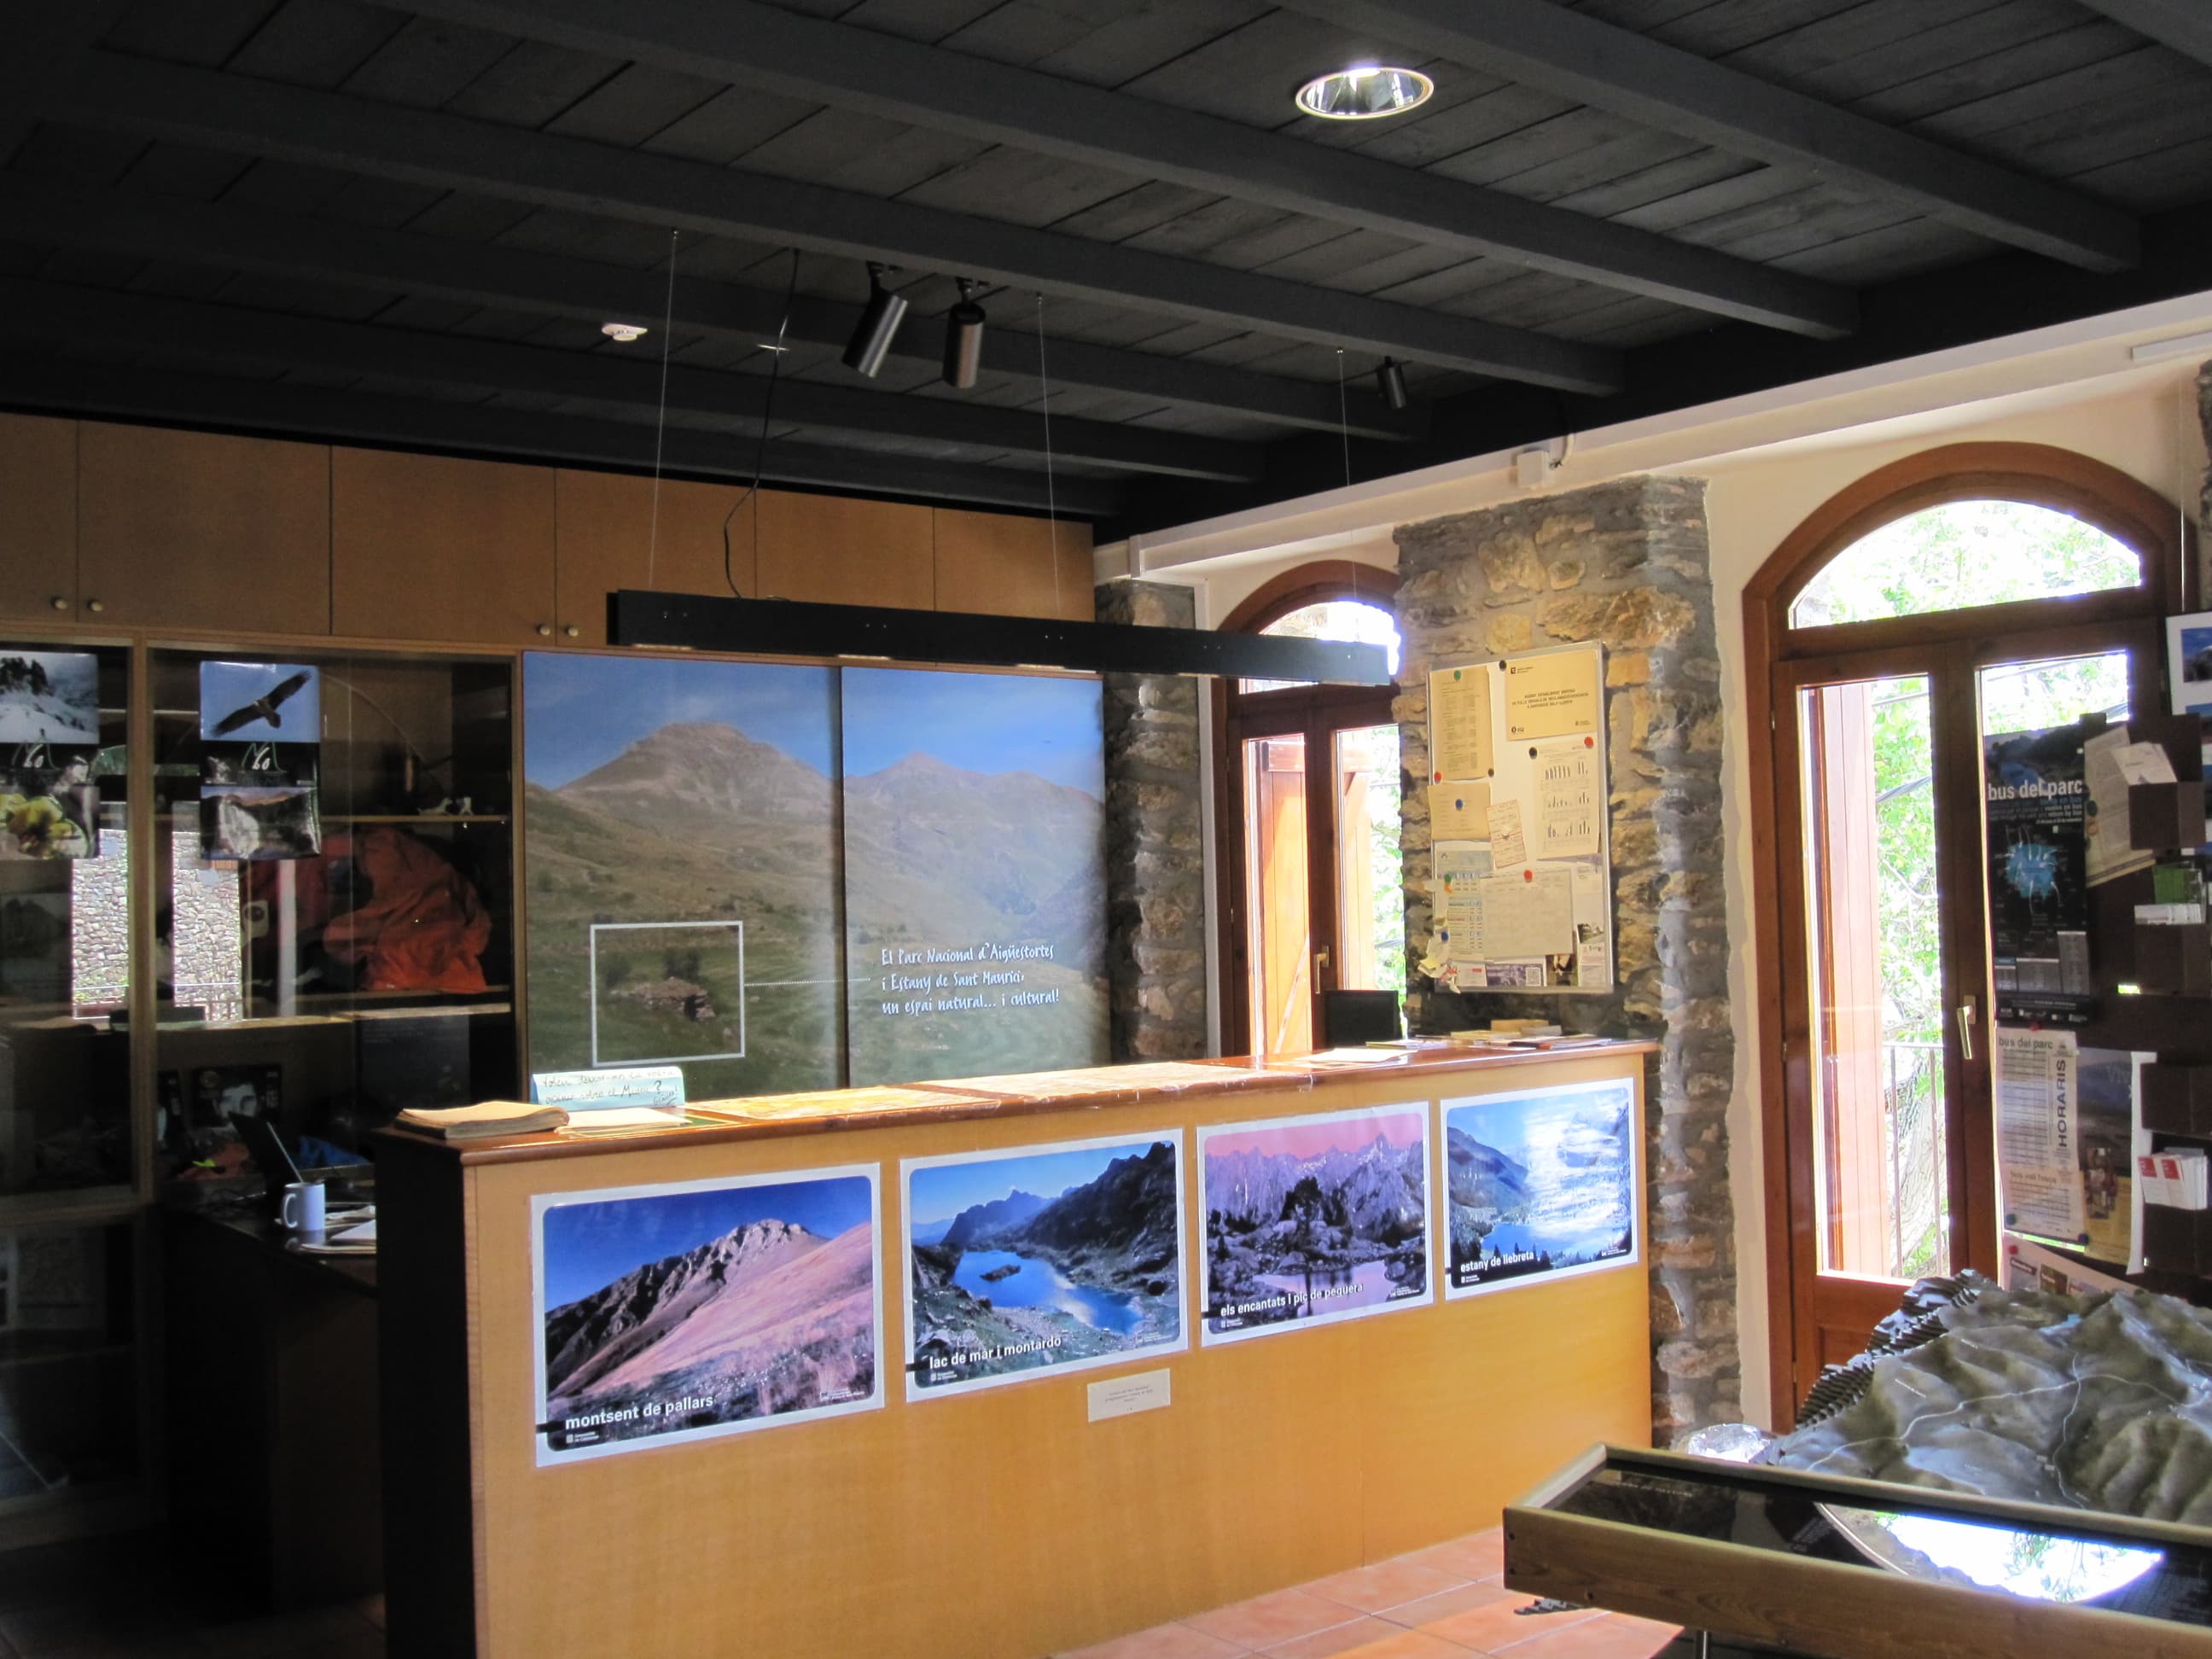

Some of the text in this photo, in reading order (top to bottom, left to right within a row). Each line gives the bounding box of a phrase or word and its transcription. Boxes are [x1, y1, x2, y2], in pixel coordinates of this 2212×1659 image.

[1988, 778, 2083, 800] bus del parc
[882, 948, 893, 965] El
[899, 948, 922, 964] Parc
[927, 947, 974, 963] Nacional
[882, 978, 886, 991] i
[891, 973, 931, 995] Estany
[935, 974, 948, 988] de
[953, 971, 978, 987] Sant
[882, 987, 1060, 1017] un espai natural... i cultural!
[1999, 1038, 2015, 1046] bus
[2017, 1038, 2031, 1048] del
[2033, 1039, 2053, 1051] parc
[2056, 1059, 2068, 1148] HORARIS
[1460, 1251, 1534, 1273] estany de llebreta
[1220, 1284, 1364, 1317] els encantats i pic de peguera
[929, 1335, 1062, 1369] lac de mar i montardo
[565, 1396, 713, 1430] montsent de pallars
